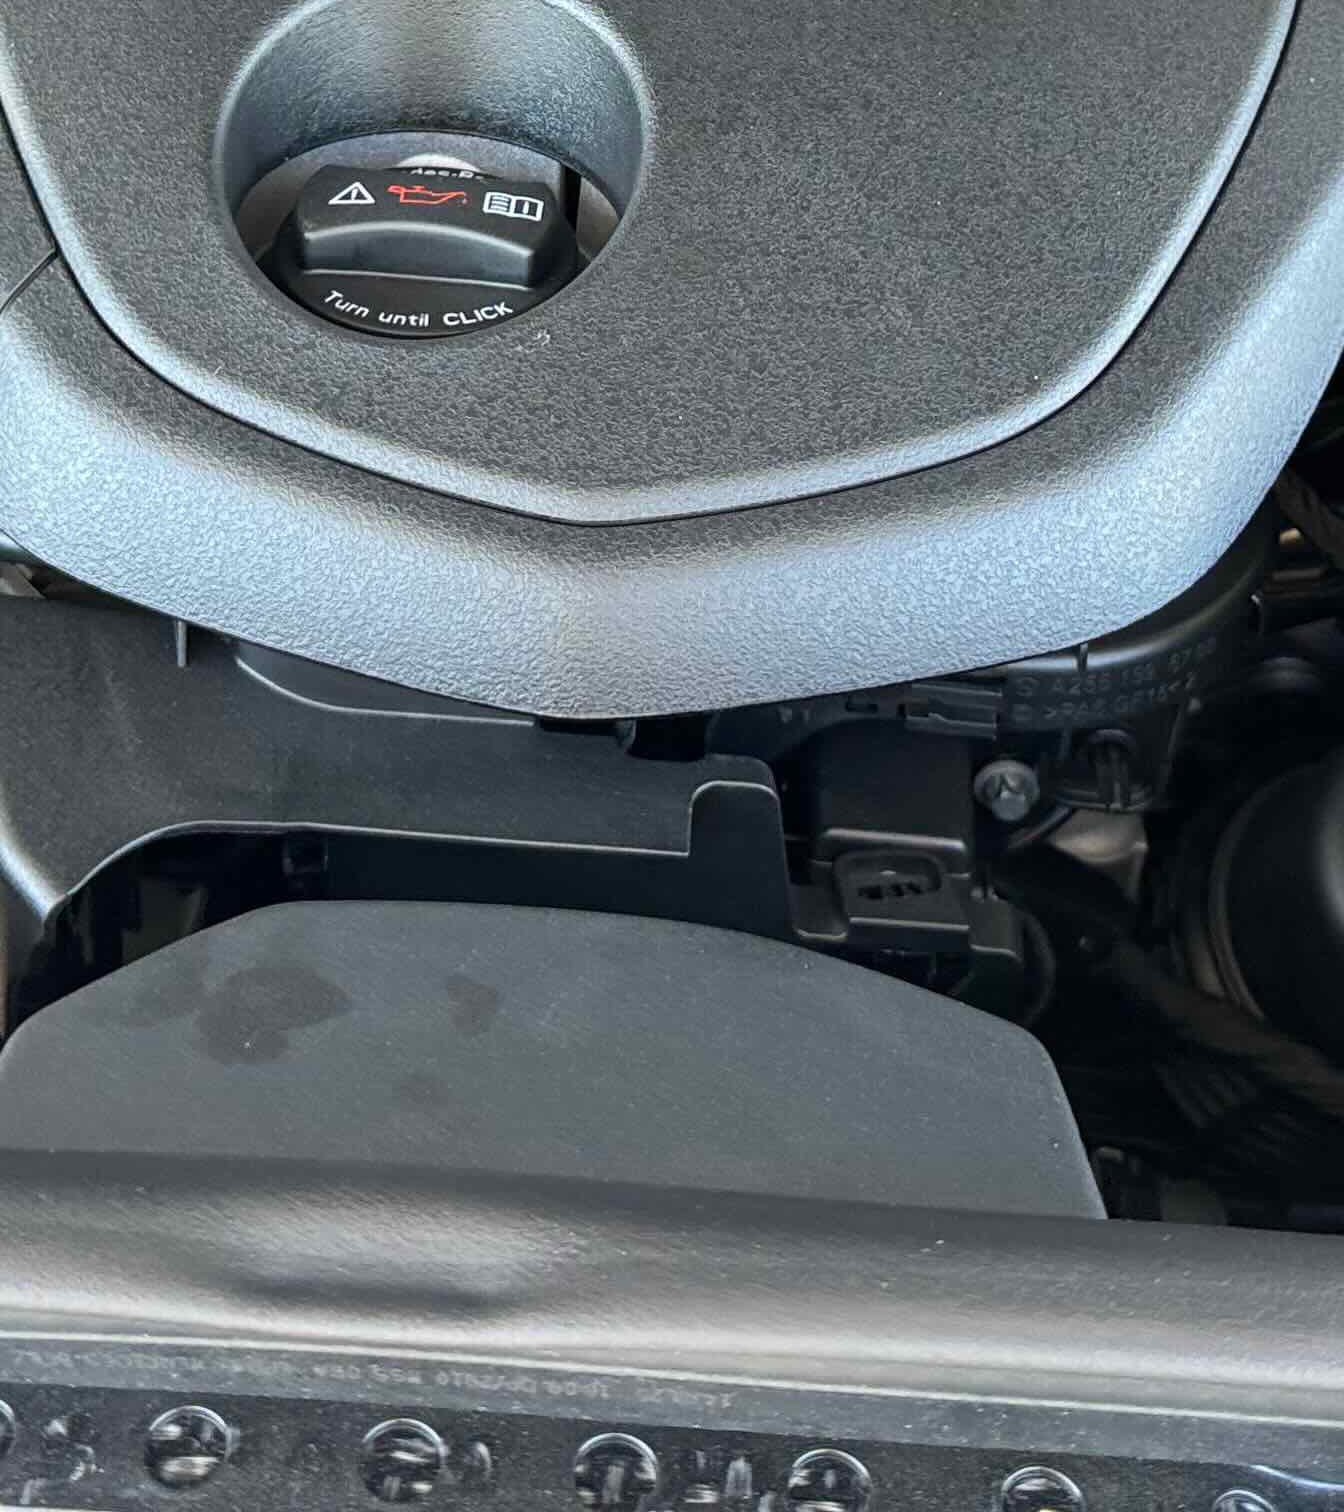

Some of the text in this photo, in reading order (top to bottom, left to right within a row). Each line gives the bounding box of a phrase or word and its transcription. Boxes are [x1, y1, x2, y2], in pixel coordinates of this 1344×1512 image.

[322, 289, 514, 328] Turn until CLICK
